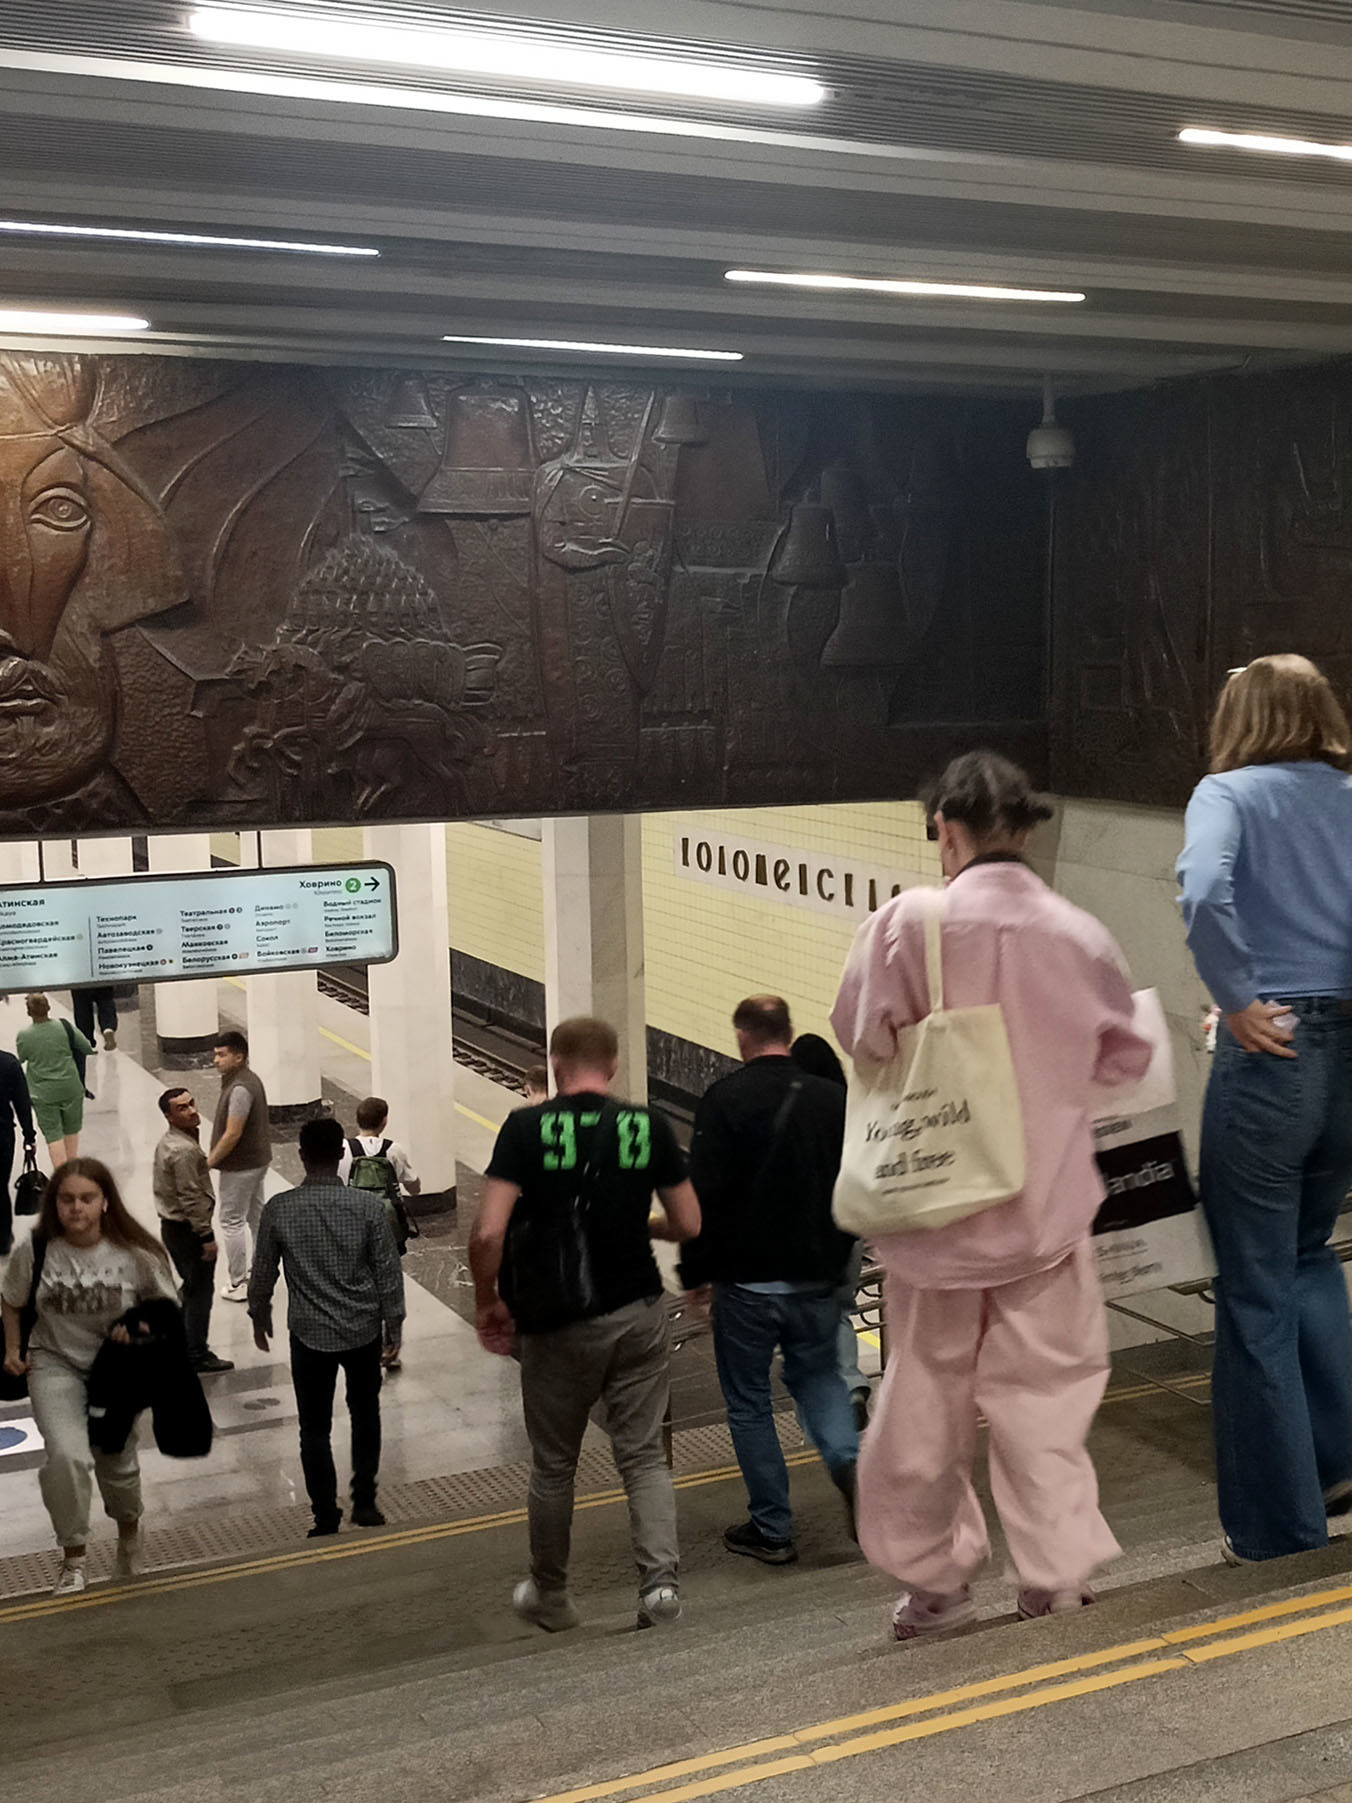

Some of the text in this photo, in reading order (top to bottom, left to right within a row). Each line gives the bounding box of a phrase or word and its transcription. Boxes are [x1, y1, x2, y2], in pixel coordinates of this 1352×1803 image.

[299, 879, 342, 889] Ховрино
[96, 915, 137, 923] Технопарк
[0, 920, 59, 930] омодедовская
[0, 935, 76, 946] расногвардейская
[98, 946, 146, 954] Павелецкая
